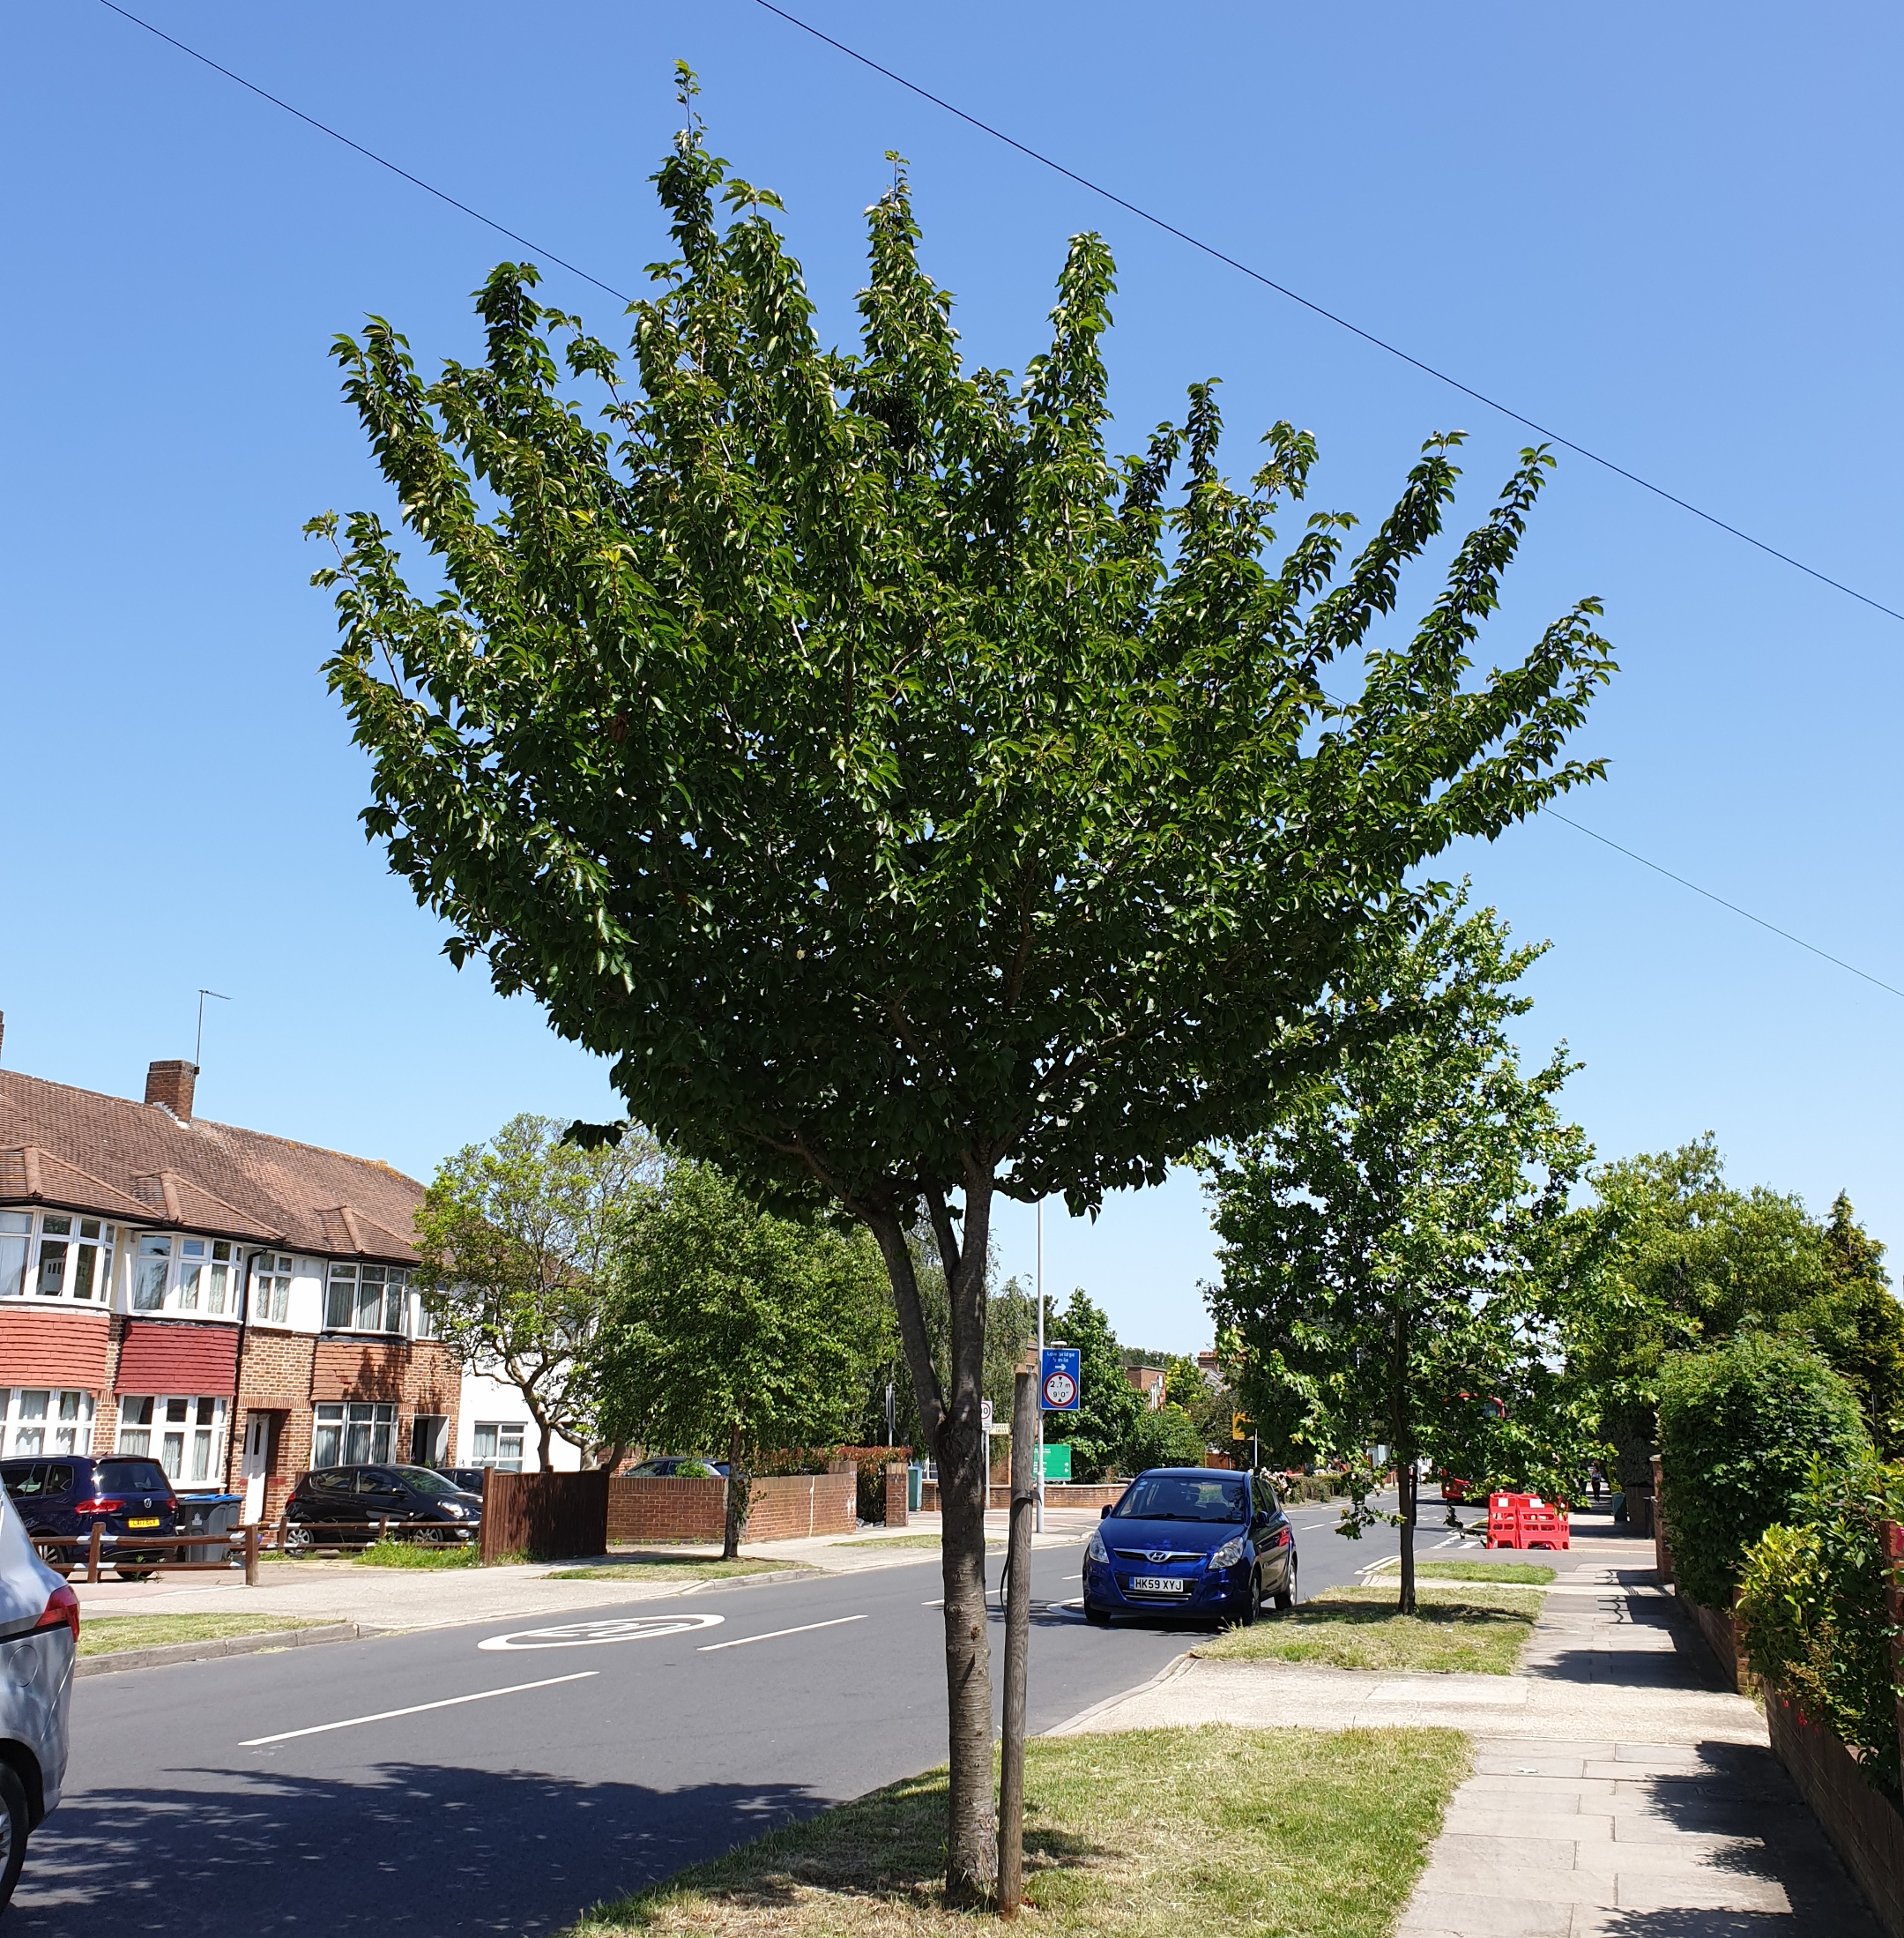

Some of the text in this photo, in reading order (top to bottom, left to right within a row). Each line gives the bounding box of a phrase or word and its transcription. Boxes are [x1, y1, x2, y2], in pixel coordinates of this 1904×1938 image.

[1050, 1380, 1063, 1389] 2.7
[1134, 1577, 1182, 1590] HK59 XYJ
[526, 1621, 692, 1637] 20
